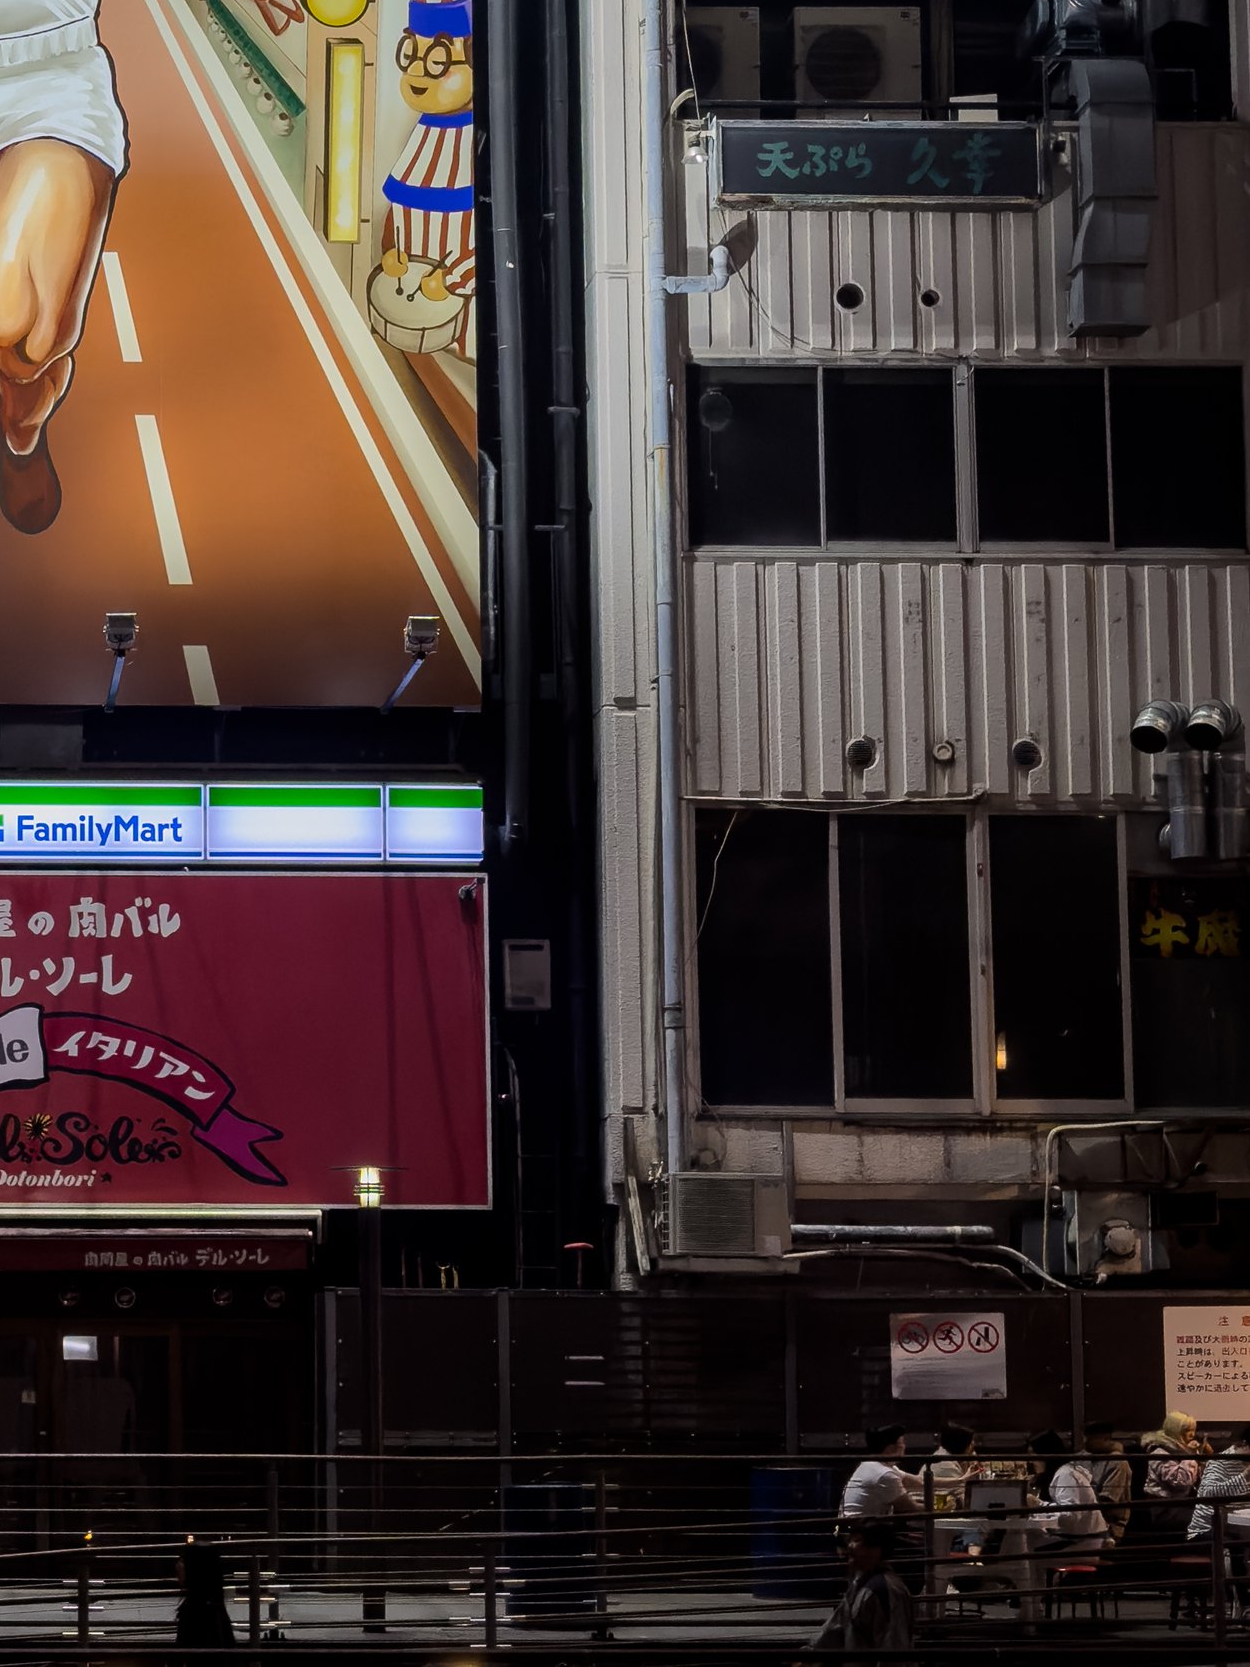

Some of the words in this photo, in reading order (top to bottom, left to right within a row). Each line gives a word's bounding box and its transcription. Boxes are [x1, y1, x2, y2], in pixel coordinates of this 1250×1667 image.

[755, 140, 873, 180] 天ぷら
[16, 814, 183, 846] FamilyMart
[27, 911, 55, 935] の
[68, 896, 181, 939] 肉バル
[53, 1030, 216, 1101] イタリアン
[42, 1111, 152, 1165] Sole
